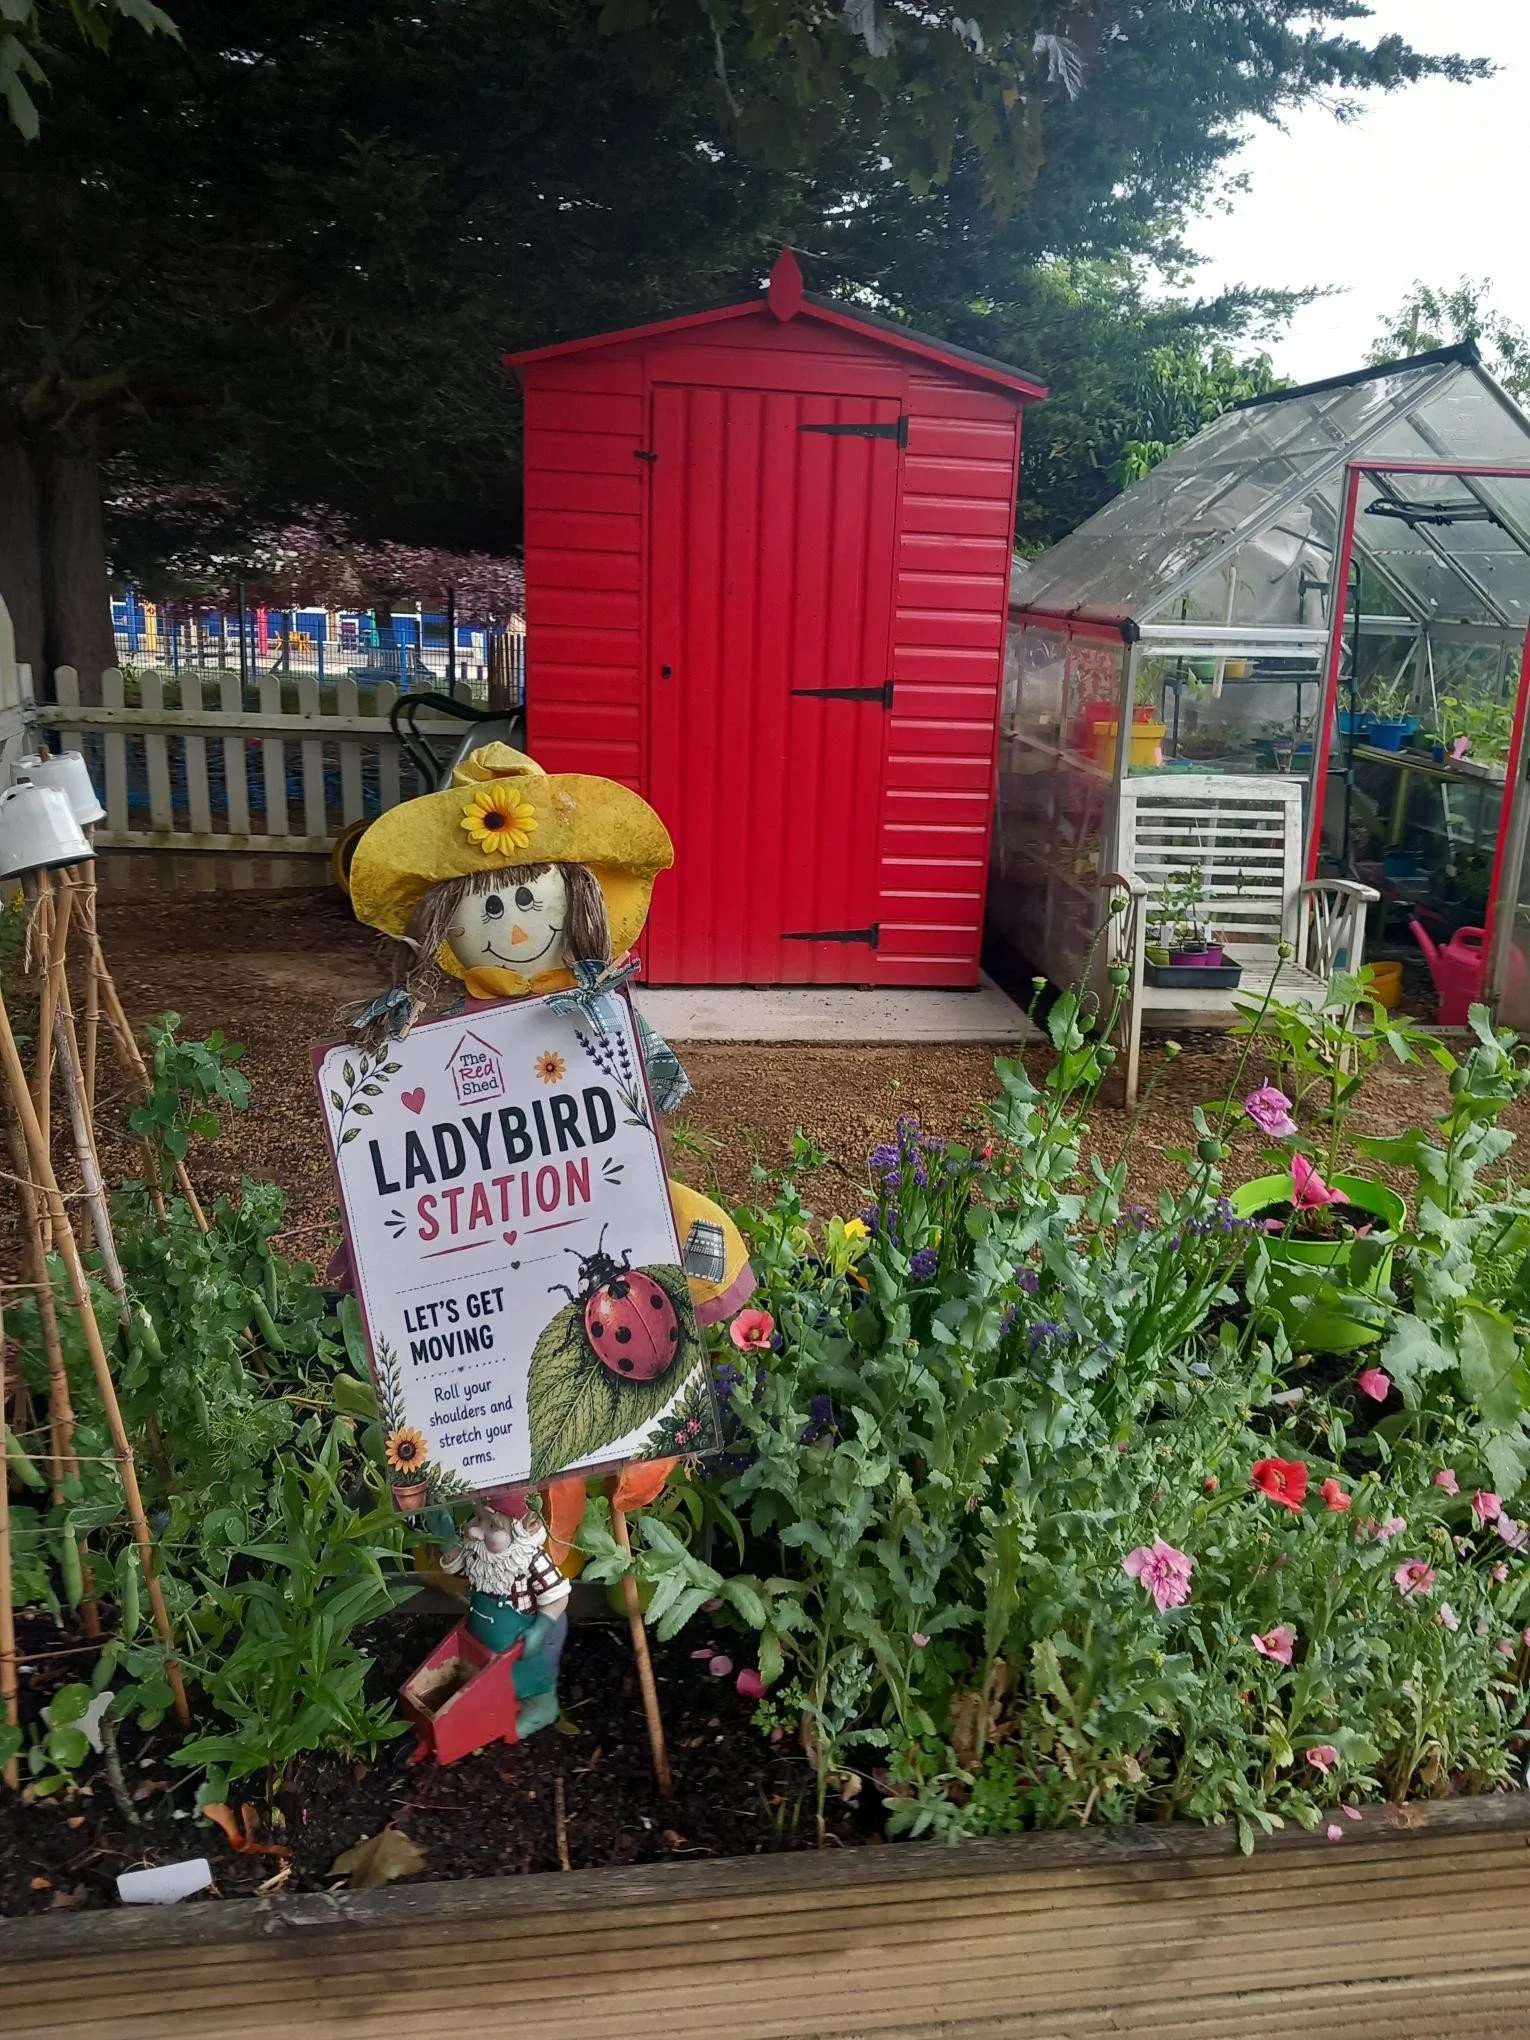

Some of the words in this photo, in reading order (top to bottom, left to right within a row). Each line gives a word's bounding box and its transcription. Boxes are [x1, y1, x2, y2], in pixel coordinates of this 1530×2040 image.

[459, 1057, 495, 1082] Red
[460, 1053, 487, 1067] The
[462, 1077, 500, 1096] Shed
[368, 1086, 617, 1196] LADYBIRD
[417, 1156, 591, 1242] STATION
[403, 1298, 460, 1334] LET'S
[466, 1286, 505, 1319] GET
[409, 1324, 494, 1367] MOVING
[434, 1383, 460, 1403] Roll
[463, 1379, 493, 1402] your
[429, 1403, 487, 1427] shoulders
[490, 1395, 513, 1414] and
[439, 1425, 482, 1449] stretch
[485, 1422, 513, 1444] your
[462, 1450, 496, 1467] arms.
